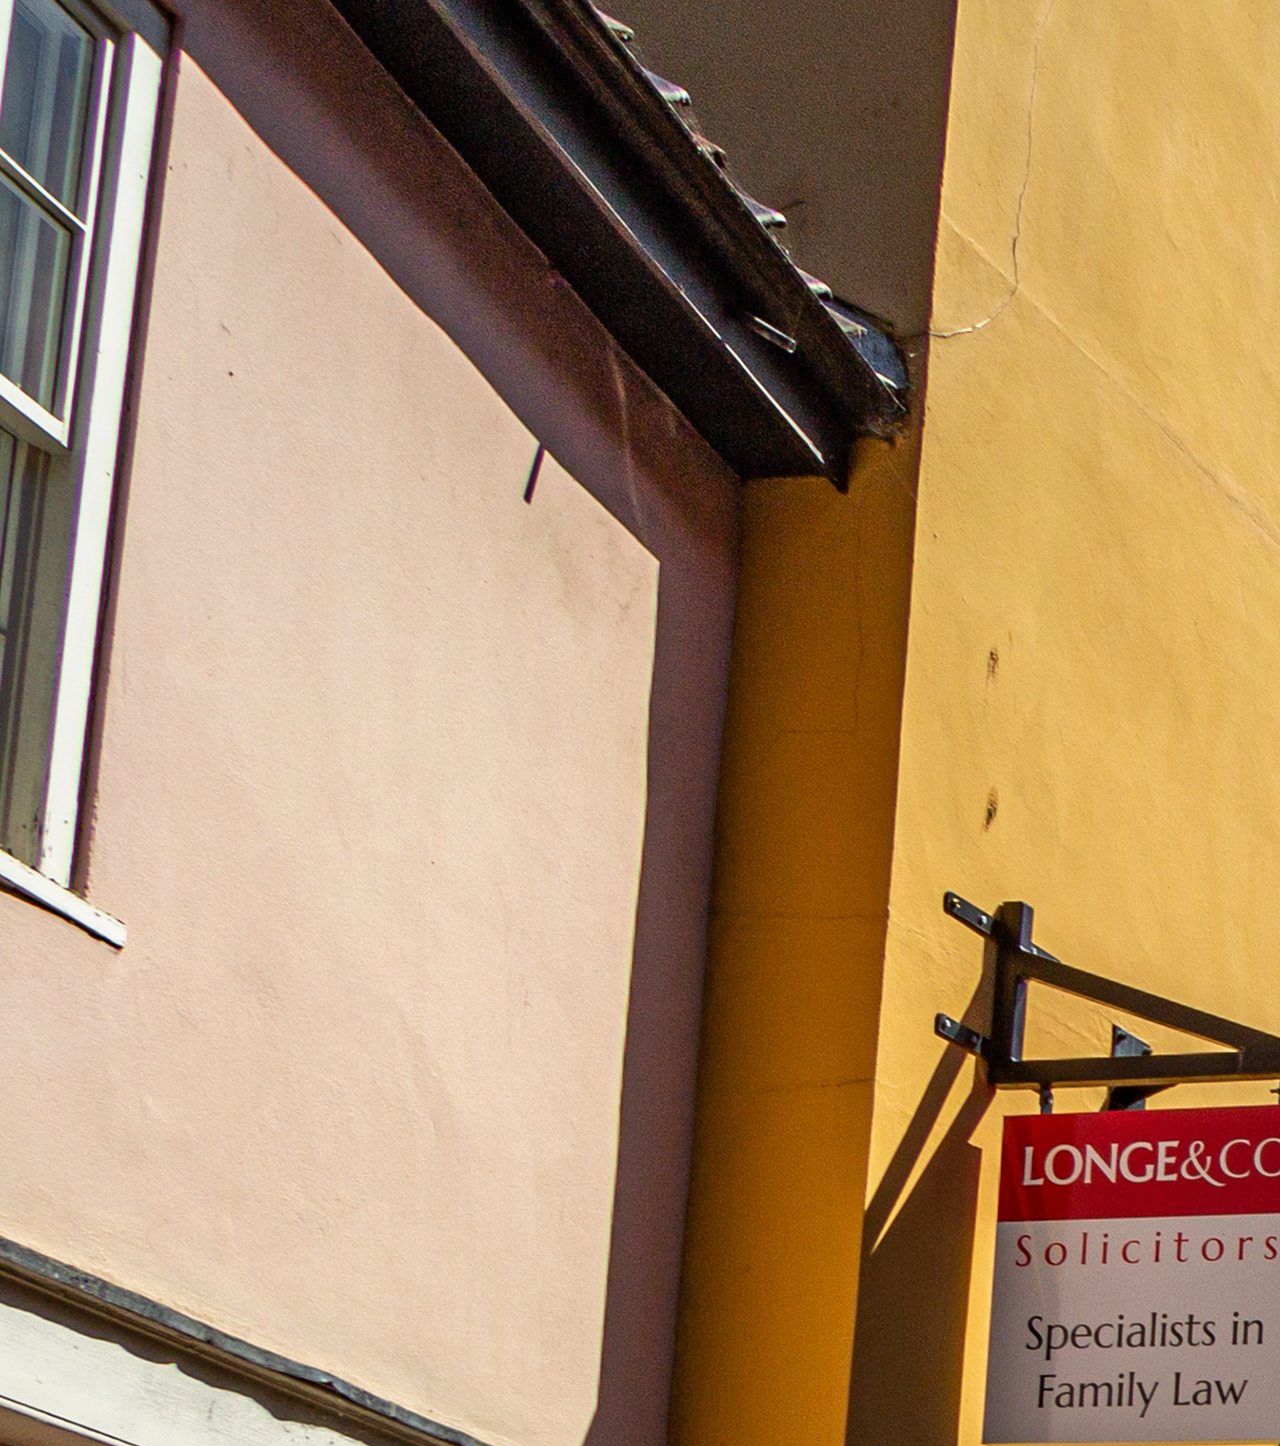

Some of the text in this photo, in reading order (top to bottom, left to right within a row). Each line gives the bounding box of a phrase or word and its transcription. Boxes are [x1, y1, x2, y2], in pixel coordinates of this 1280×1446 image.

[1015, 1230, 1278, 1267] Solicitors
[1025, 1311, 1264, 1360] Specialists in
[1037, 1371, 1248, 1418] Family Law
